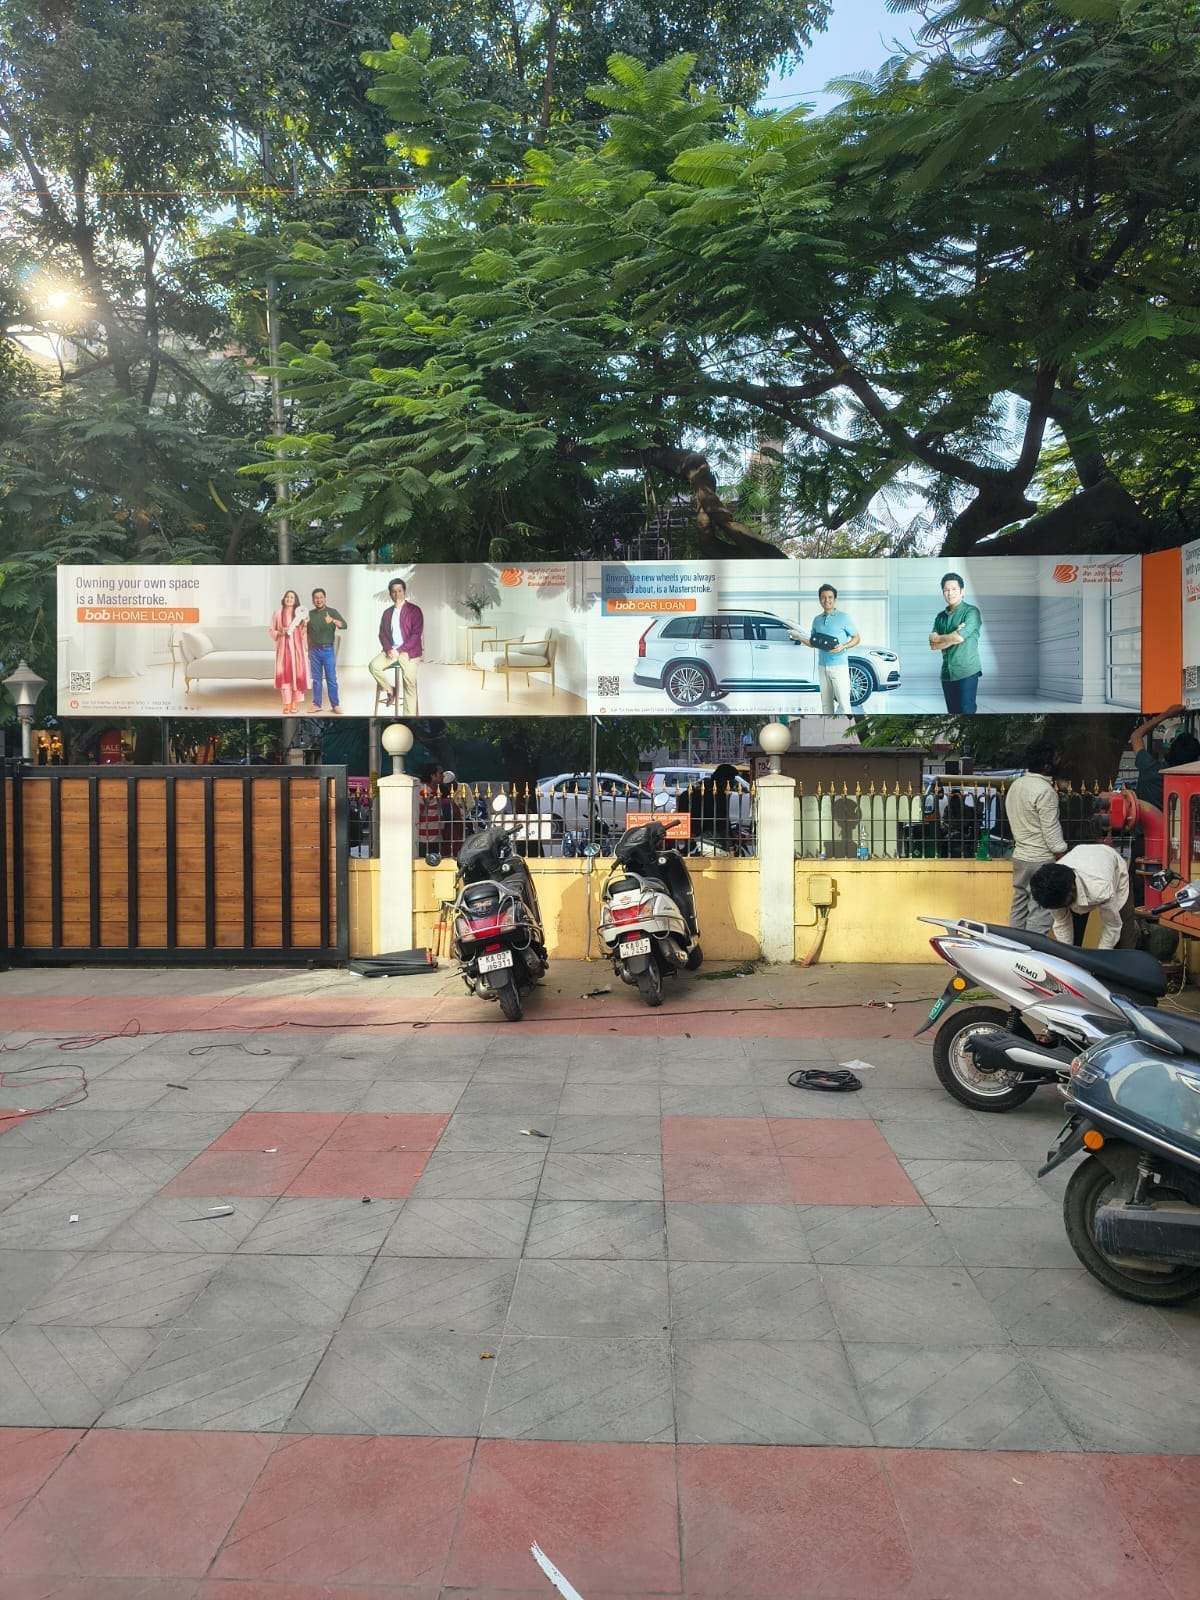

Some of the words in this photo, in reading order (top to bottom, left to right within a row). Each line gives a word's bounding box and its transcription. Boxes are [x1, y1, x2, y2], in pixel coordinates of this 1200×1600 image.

[76, 576, 115, 591] Owning
[118, 579, 141, 591] your
[144, 579, 166, 588] own
[169, 579, 200, 591] space
[629, 573, 640, 581] the
[656, 573, 678, 582] wheels
[679, 575, 691, 584] you
[693, 573, 716, 583] always
[635, 585, 655, 594] about,
[656, 585, 663, 593] is
[669, 584, 712, 593] Masterstroke.
[76, 593, 85, 605] is
[87, 596, 94, 605] a
[97, 593, 168, 605] Masterstroke.
[615, 600, 635, 610] bob
[638, 602, 657, 610] CAR
[660, 601, 686, 610] LOAN
[85, 609, 111, 620] bob
[112, 611, 148, 620] HOME
[152, 611, 184, 620] LOAN
[1015, 962, 1038, 980] NEMO
